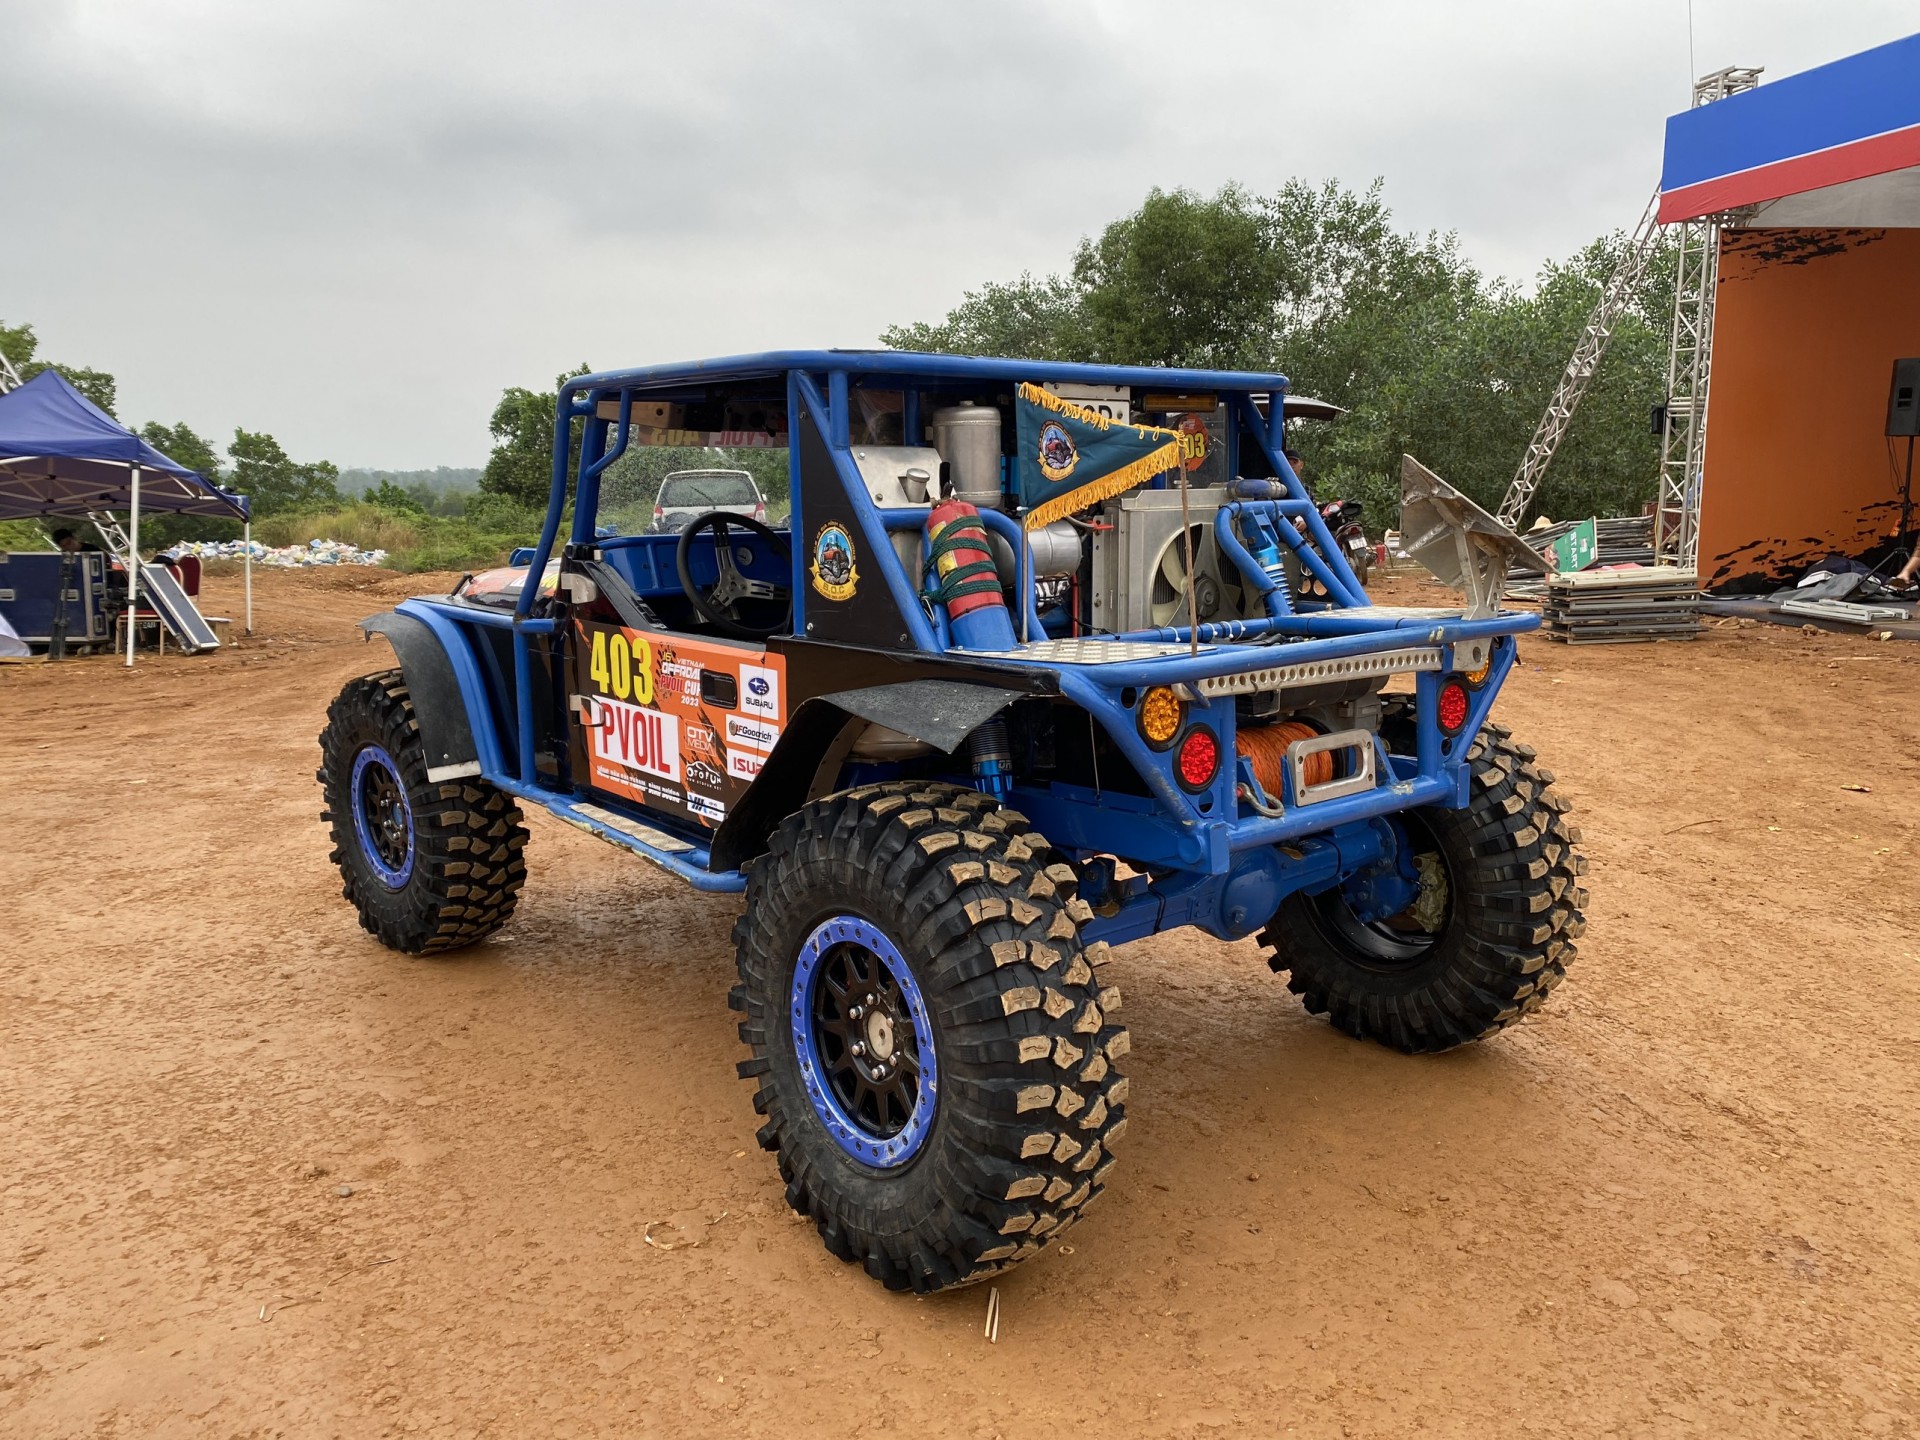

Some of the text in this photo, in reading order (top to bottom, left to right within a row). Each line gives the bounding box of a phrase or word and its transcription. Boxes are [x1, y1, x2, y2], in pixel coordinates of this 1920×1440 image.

[1185, 432, 1205, 459] 03
[1570, 531, 1578, 568] START
[591, 631, 653, 704] 403
[661, 661, 701, 681] OFFROA
[676, 657, 705, 669] VIETNAM
[660, 675, 684, 693] PVOIL
[680, 694, 699, 707] 2023
[745, 696, 774, 710] SUBARU
[601, 703, 671, 773] PVOIL
[687, 738, 714, 755] MEDIA
